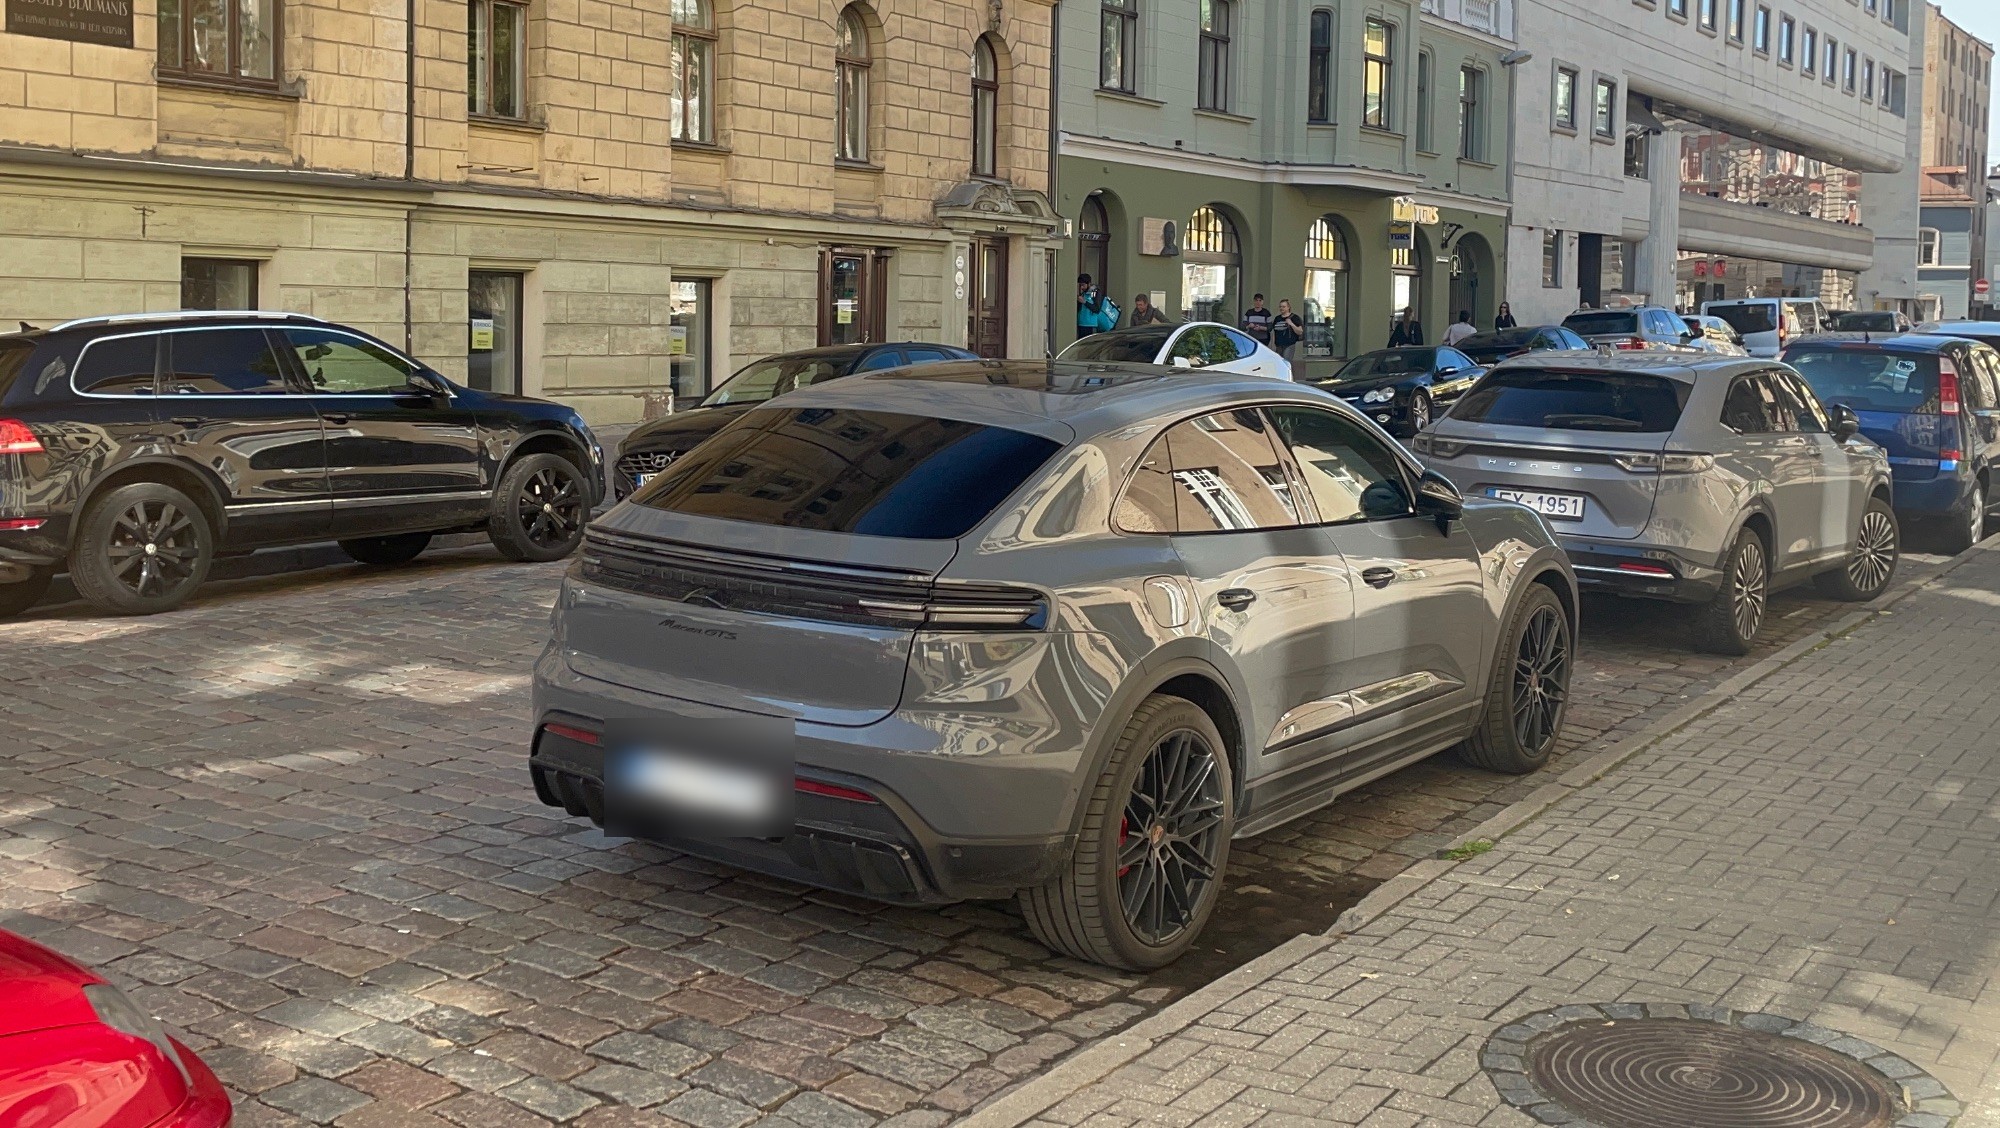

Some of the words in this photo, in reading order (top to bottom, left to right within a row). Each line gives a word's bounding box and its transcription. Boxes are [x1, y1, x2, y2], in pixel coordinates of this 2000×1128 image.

[1488, 459, 1582, 472] Honda
[658, 619, 702, 634] Macan
[704, 629, 738, 640] GTS
